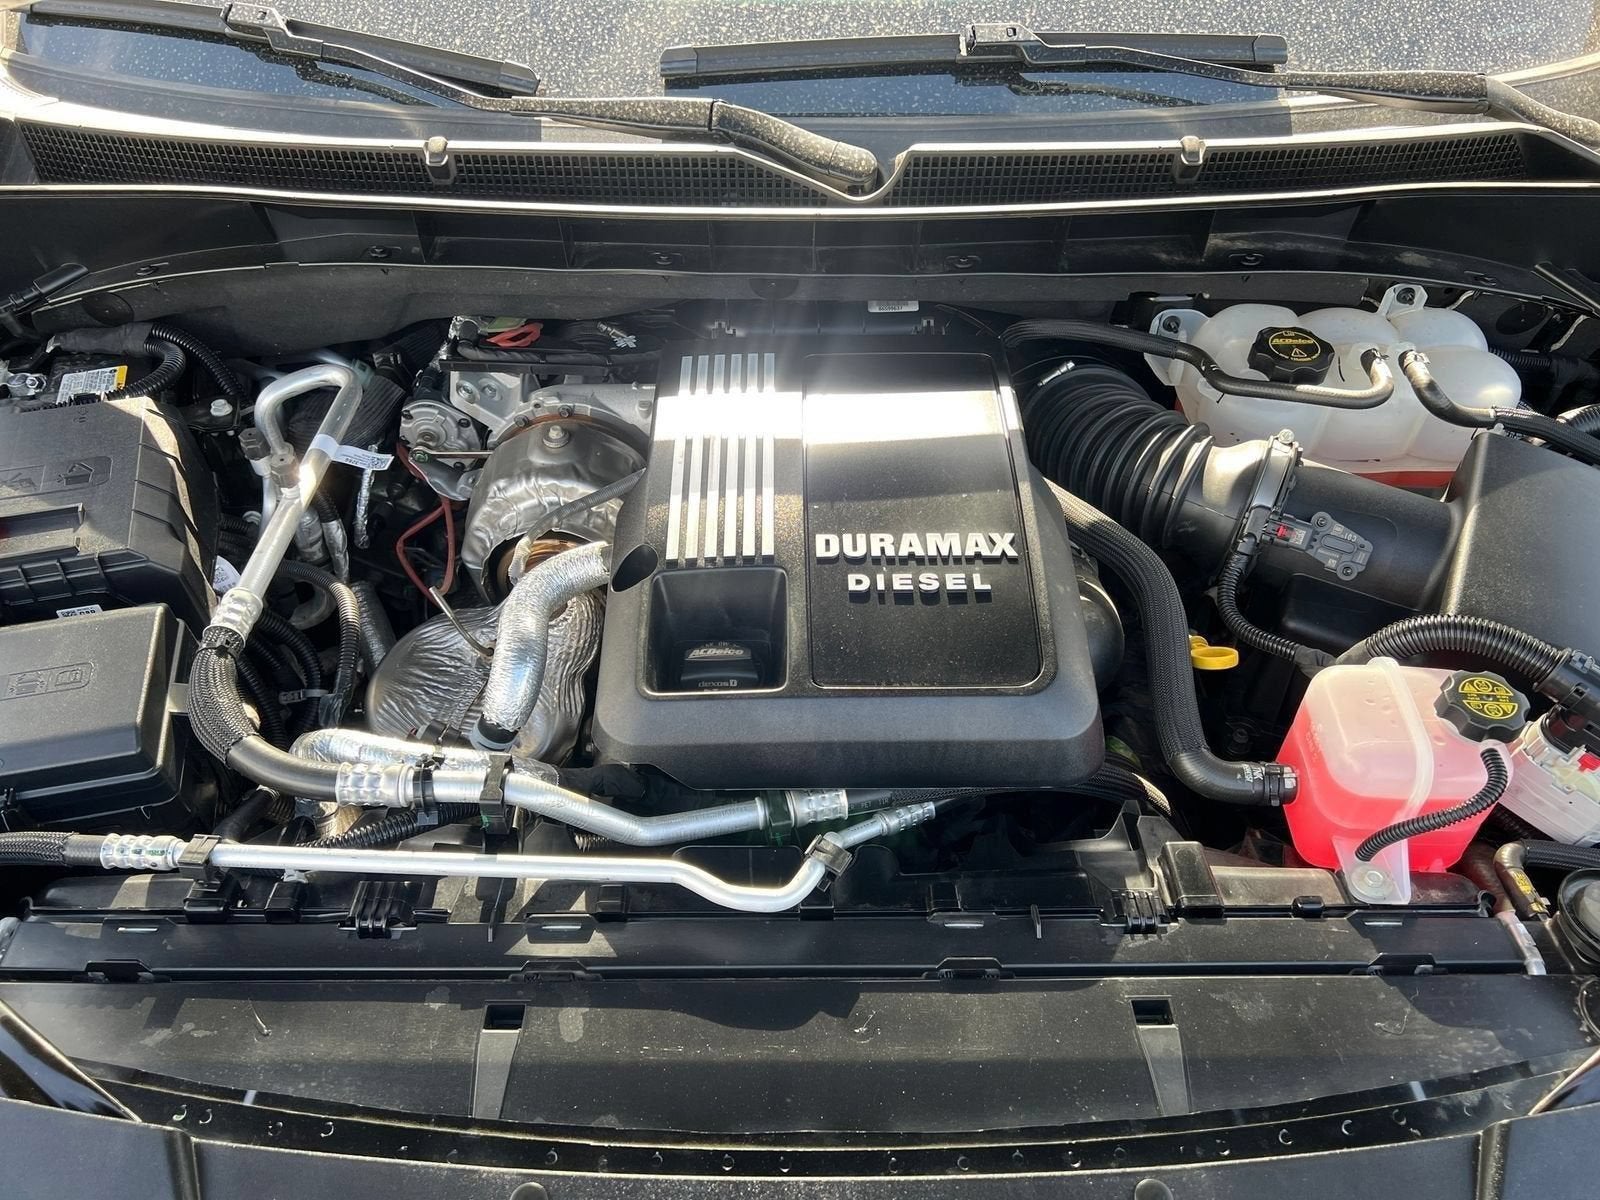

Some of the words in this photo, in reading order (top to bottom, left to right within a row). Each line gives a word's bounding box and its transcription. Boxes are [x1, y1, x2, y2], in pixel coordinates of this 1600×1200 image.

[815, 533, 1018, 558] DURAMAX
[847, 573, 992, 593] DIESEL
[687, 647, 745, 659] ACDelco
